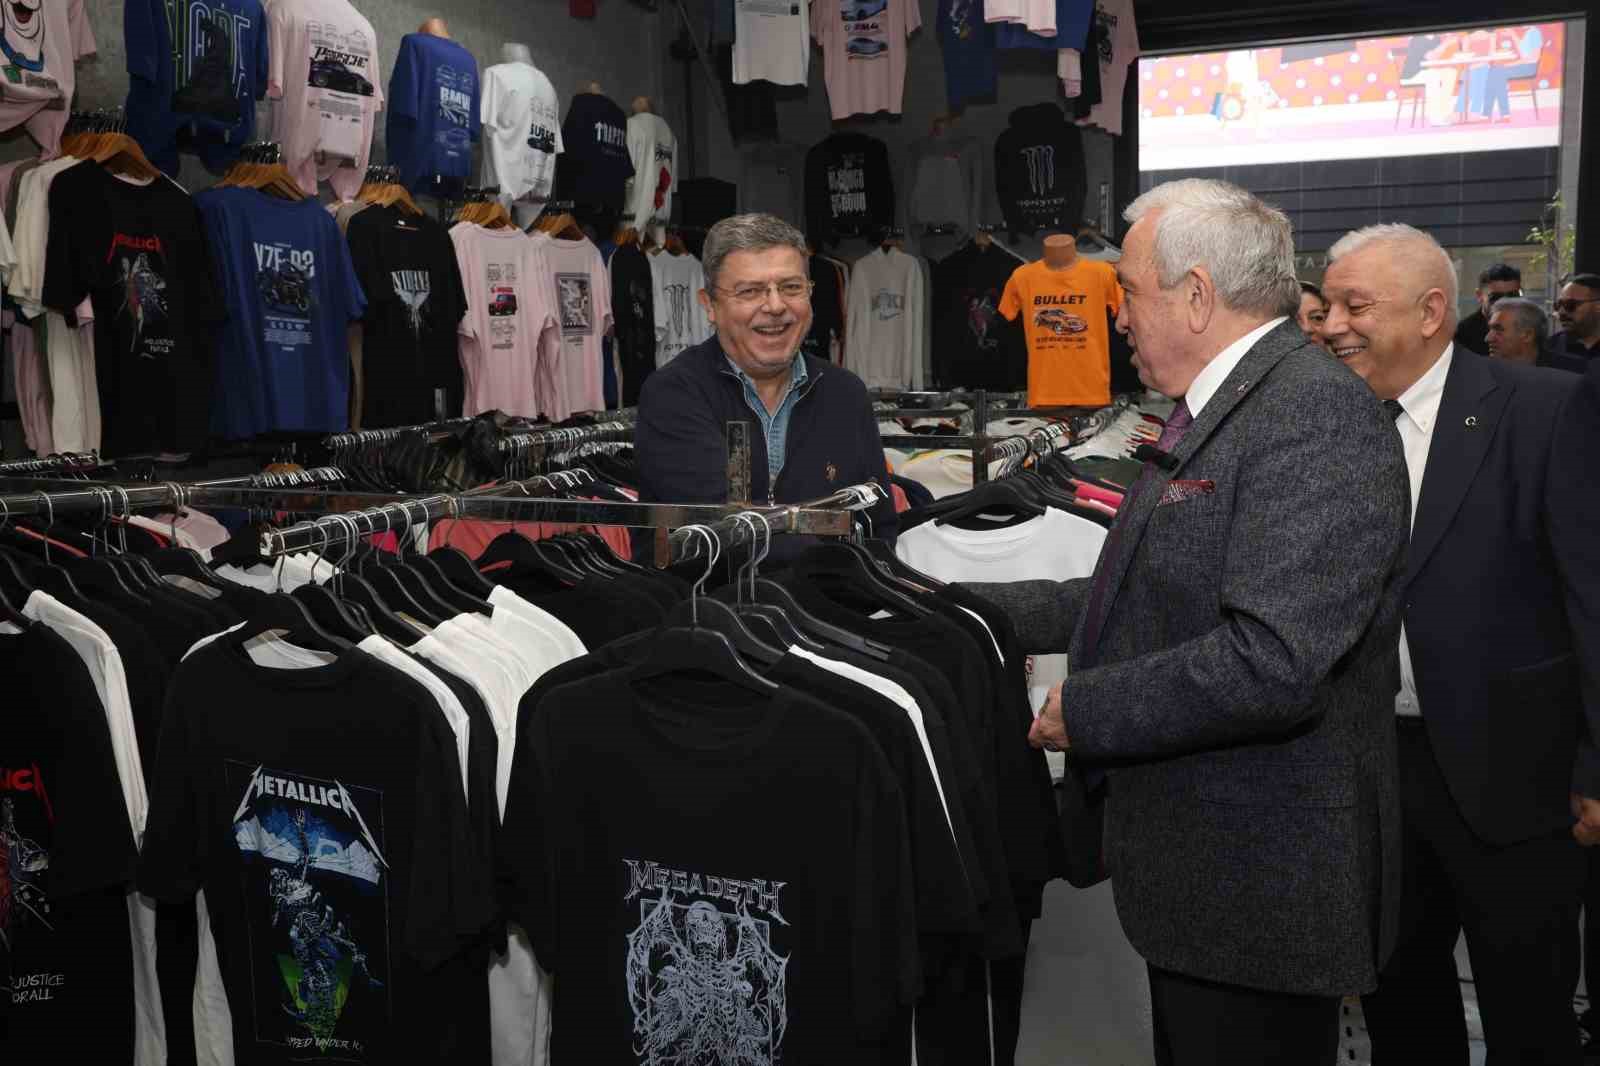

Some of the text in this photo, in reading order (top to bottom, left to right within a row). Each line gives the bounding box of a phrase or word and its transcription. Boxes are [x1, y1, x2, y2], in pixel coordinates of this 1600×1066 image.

[440, 86, 471, 112] BMW
[1034, 295, 1087, 305] BULLET
[233, 763, 390, 869] METALLICA
[621, 857, 792, 927] MEGADETH
[14, 973, 64, 989] JUSTICE
[29, 988, 55, 1000] ALL
